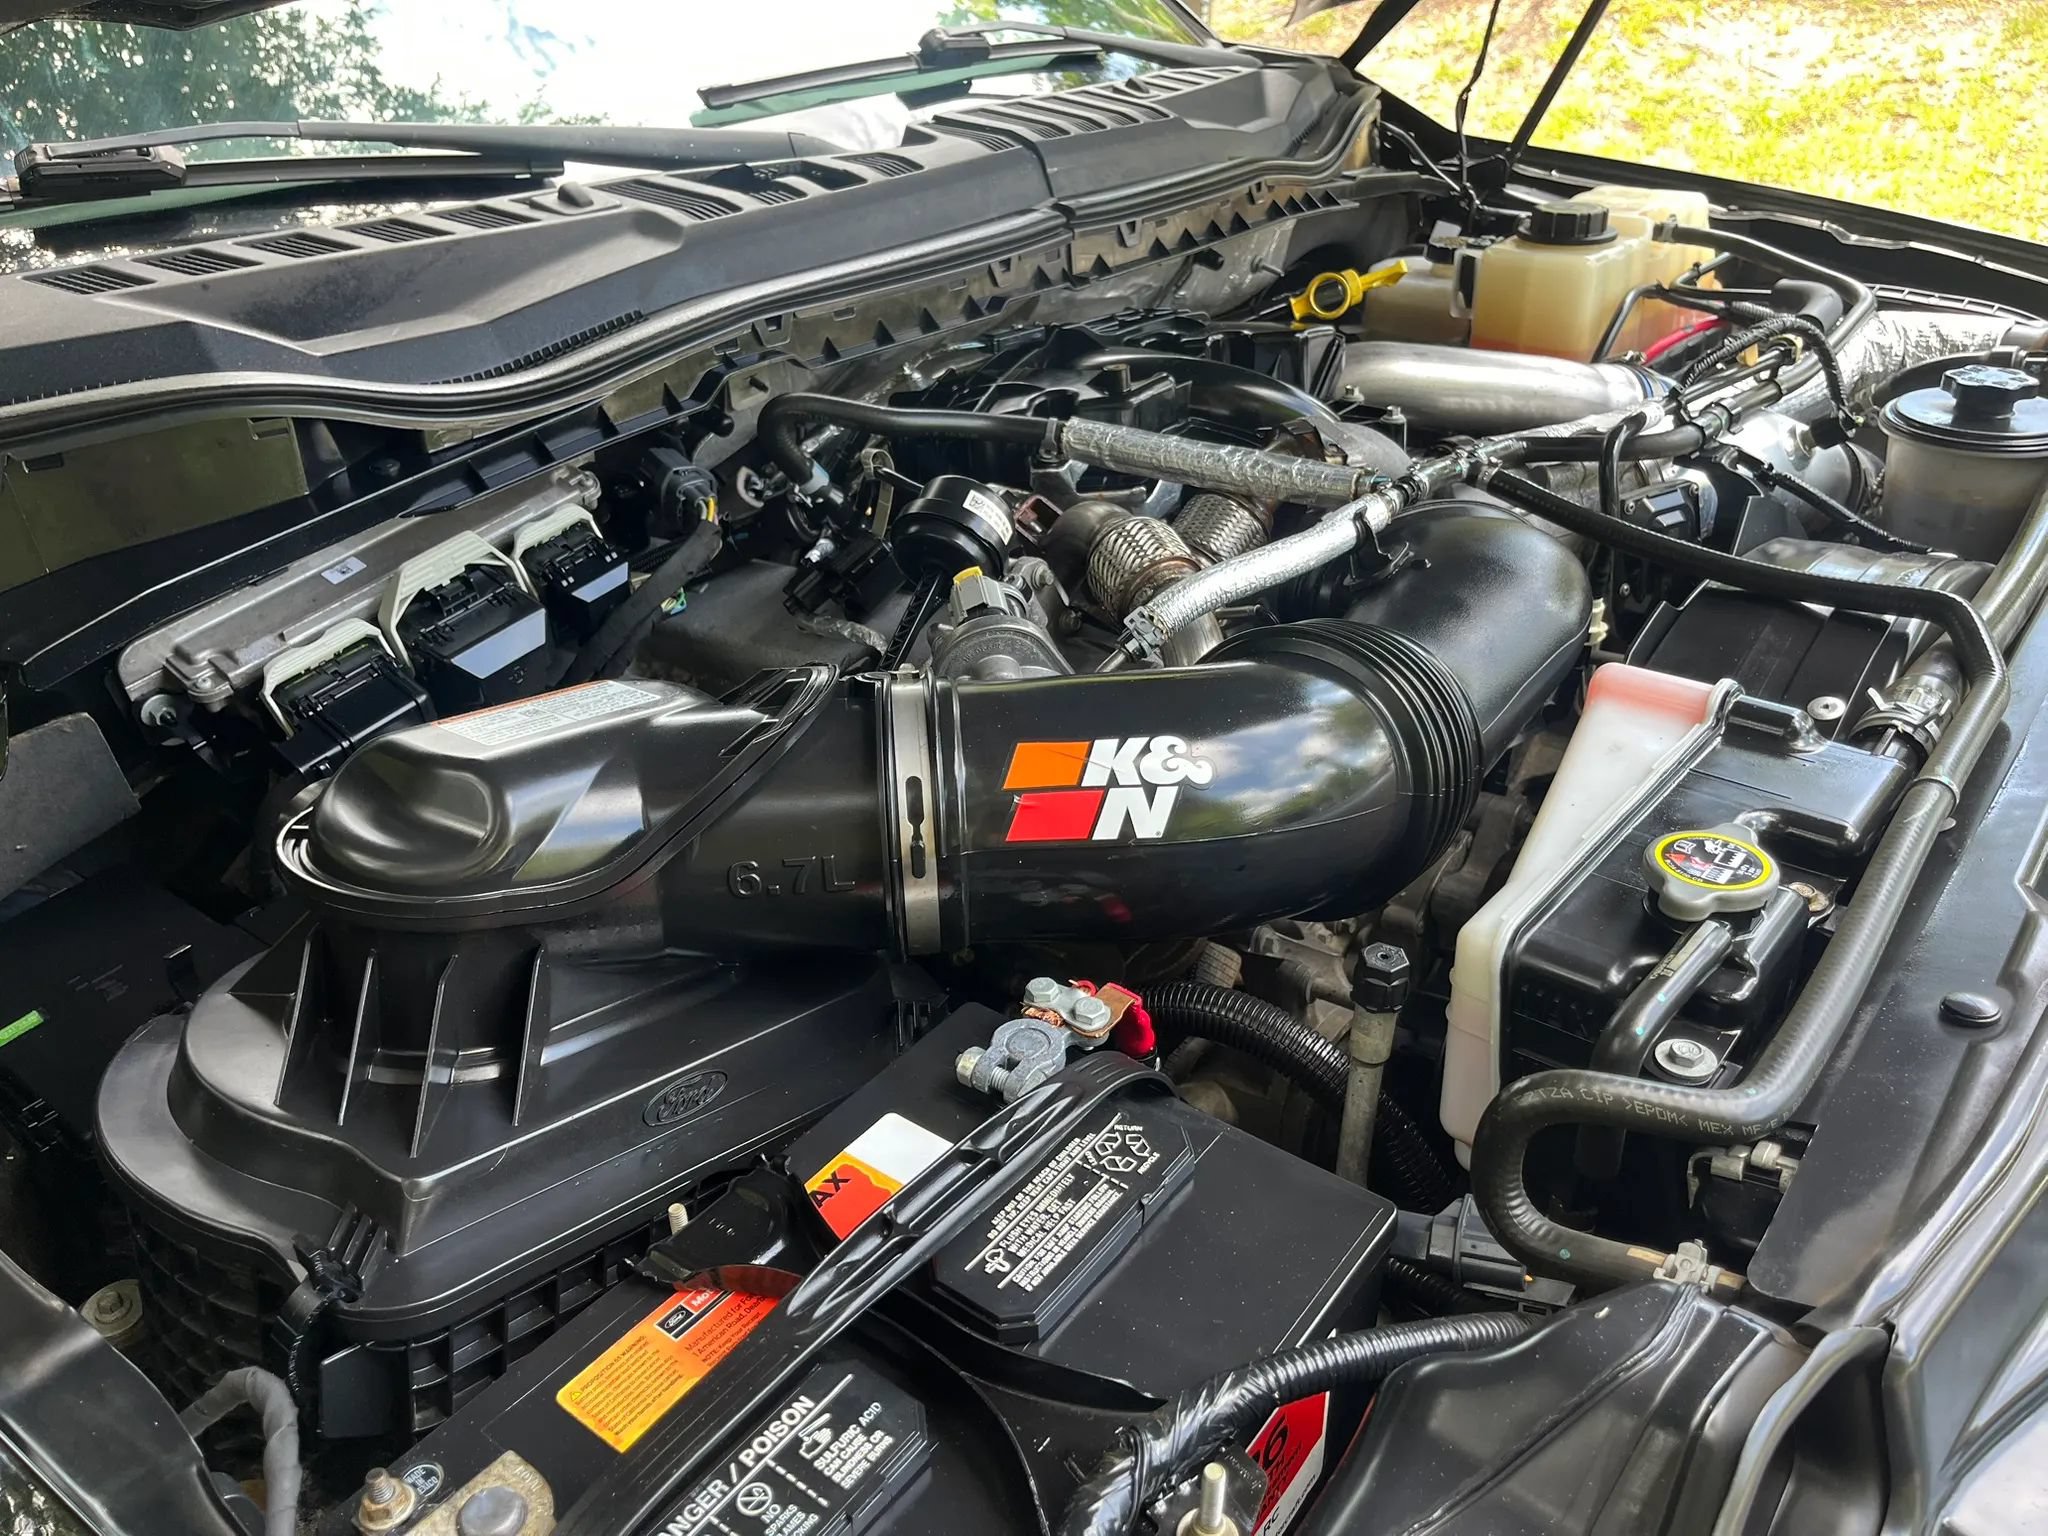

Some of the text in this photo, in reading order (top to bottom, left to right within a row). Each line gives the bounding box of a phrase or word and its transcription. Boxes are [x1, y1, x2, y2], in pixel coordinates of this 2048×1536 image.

[727, 855, 856, 897] 6.7L
[657, 1075, 716, 1122] Ford
[999, 1172, 1075, 1248] FLUSH EYES IMMEDIATELY
[1007, 1234, 1028, 1253] WITH
[1046, 1198, 1065, 1215] GET
[1016, 1198, 1076, 1258] MEDICAL HELP FAST
[695, 1326, 729, 1354] American
[813, 1402, 882, 1470] SULFURIC ACID
[822, 1433, 871, 1477] CAN CAUSE
[830, 1430, 886, 1483] BLINDNESS OR
[416, 1476, 439, 1495] EXICO
[656, 1479, 729, 1536] NGER
[738, 1395, 816, 1468] POISON
[837, 1458, 871, 1490] SEVERE
[761, 1504, 780, 1524] NO
[765, 1504, 798, 1536] SPARKS
